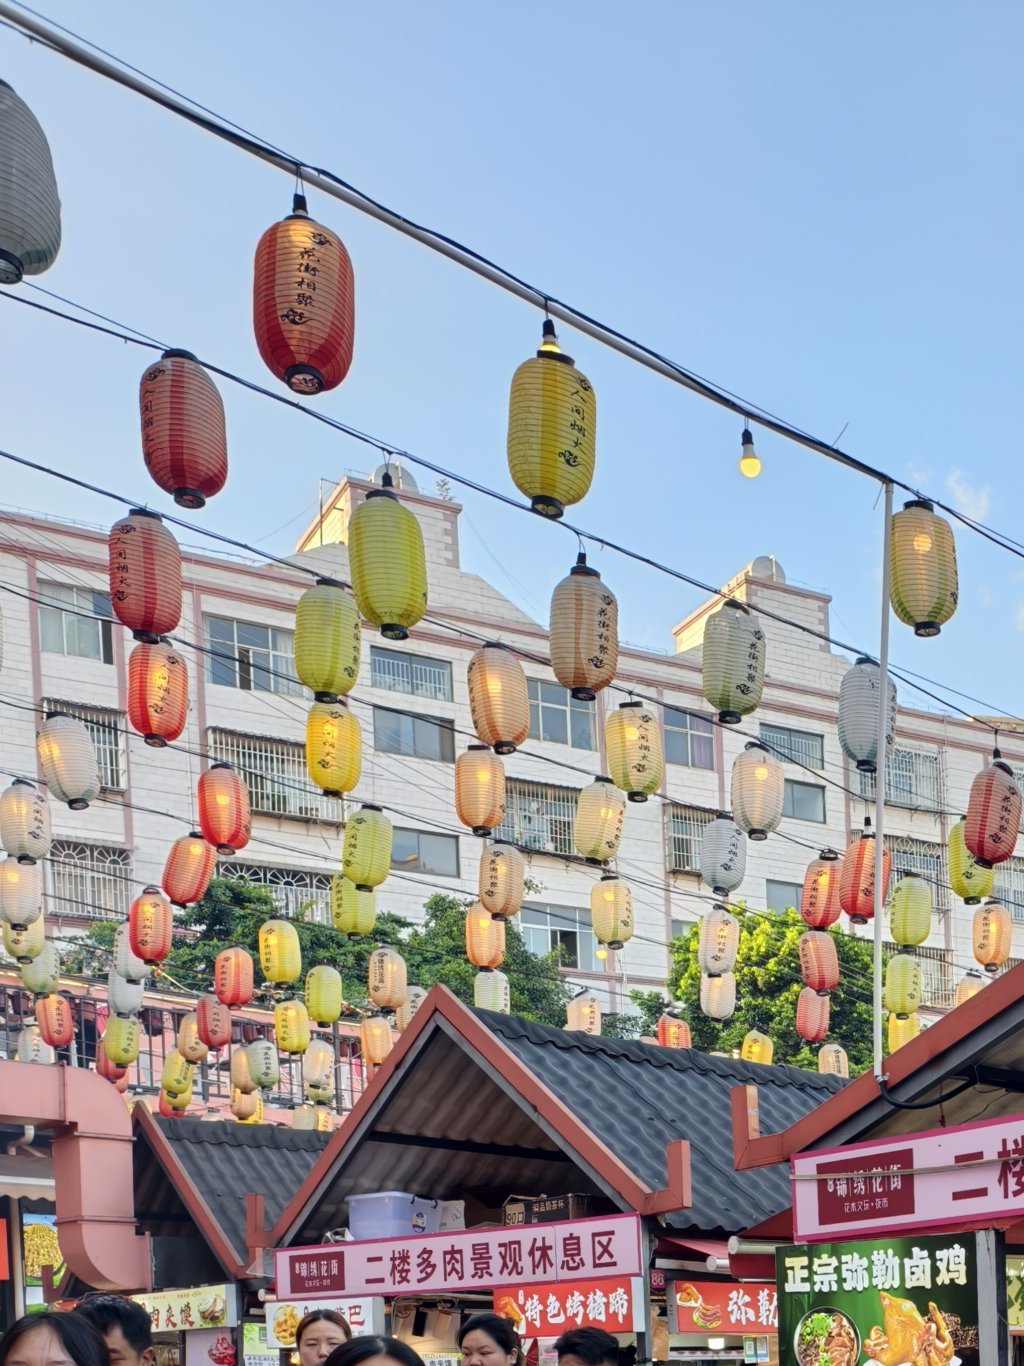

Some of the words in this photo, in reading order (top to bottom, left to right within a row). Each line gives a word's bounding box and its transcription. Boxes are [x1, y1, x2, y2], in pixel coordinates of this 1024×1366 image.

[569, 390, 588, 456] 人间烟火
[116, 536, 131, 588] 人间烟火
[364, 1230, 618, 1286] 二楼多肉景观休息区
[651, 1271, 665, 1285] 86
[784, 1243, 968, 1293] 正宗弥勒卤鸡
[524, 1287, 629, 1328] 特色烤猪蹄
